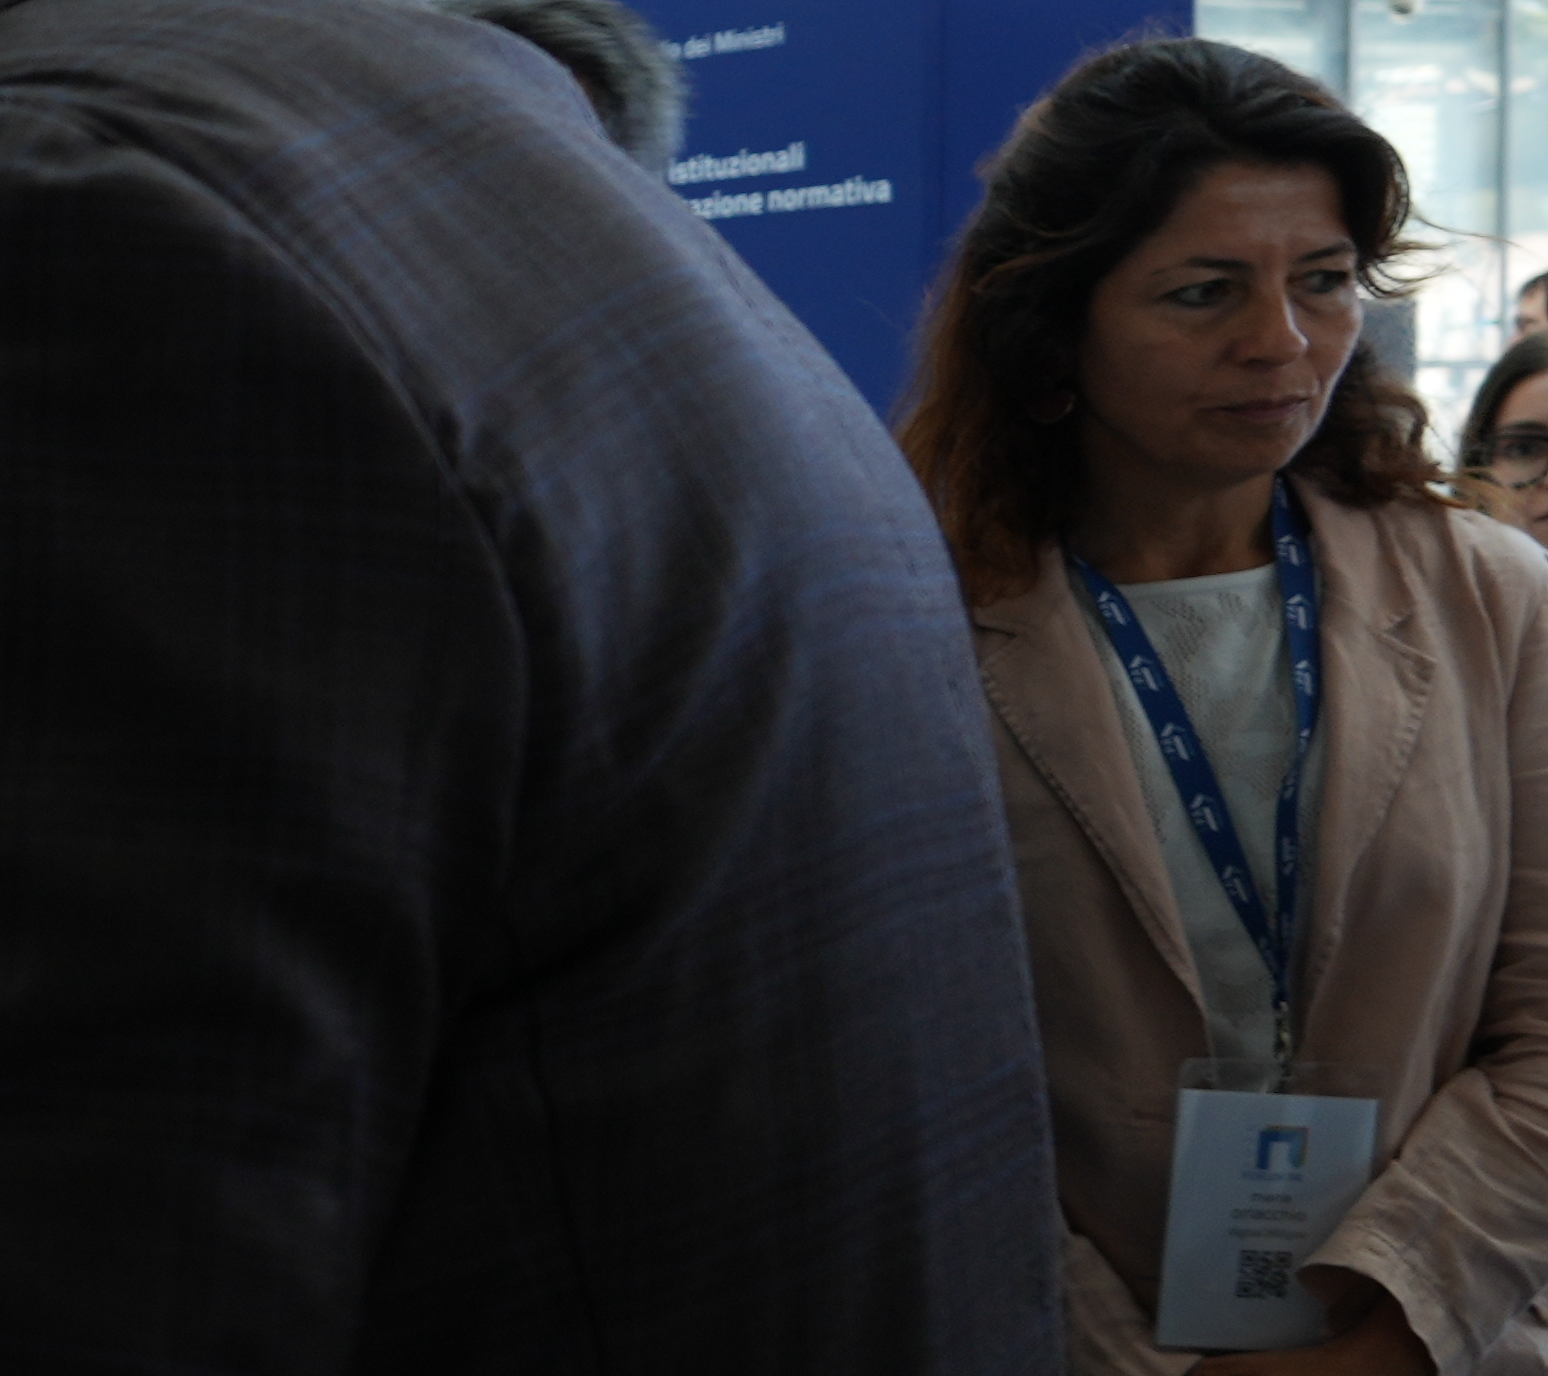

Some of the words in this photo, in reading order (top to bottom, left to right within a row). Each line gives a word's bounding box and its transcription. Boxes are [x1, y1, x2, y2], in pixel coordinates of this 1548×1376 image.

[683, 35, 712, 60] dei
[713, 22, 786, 54] Ministri
[766, 175, 893, 213] normativa
